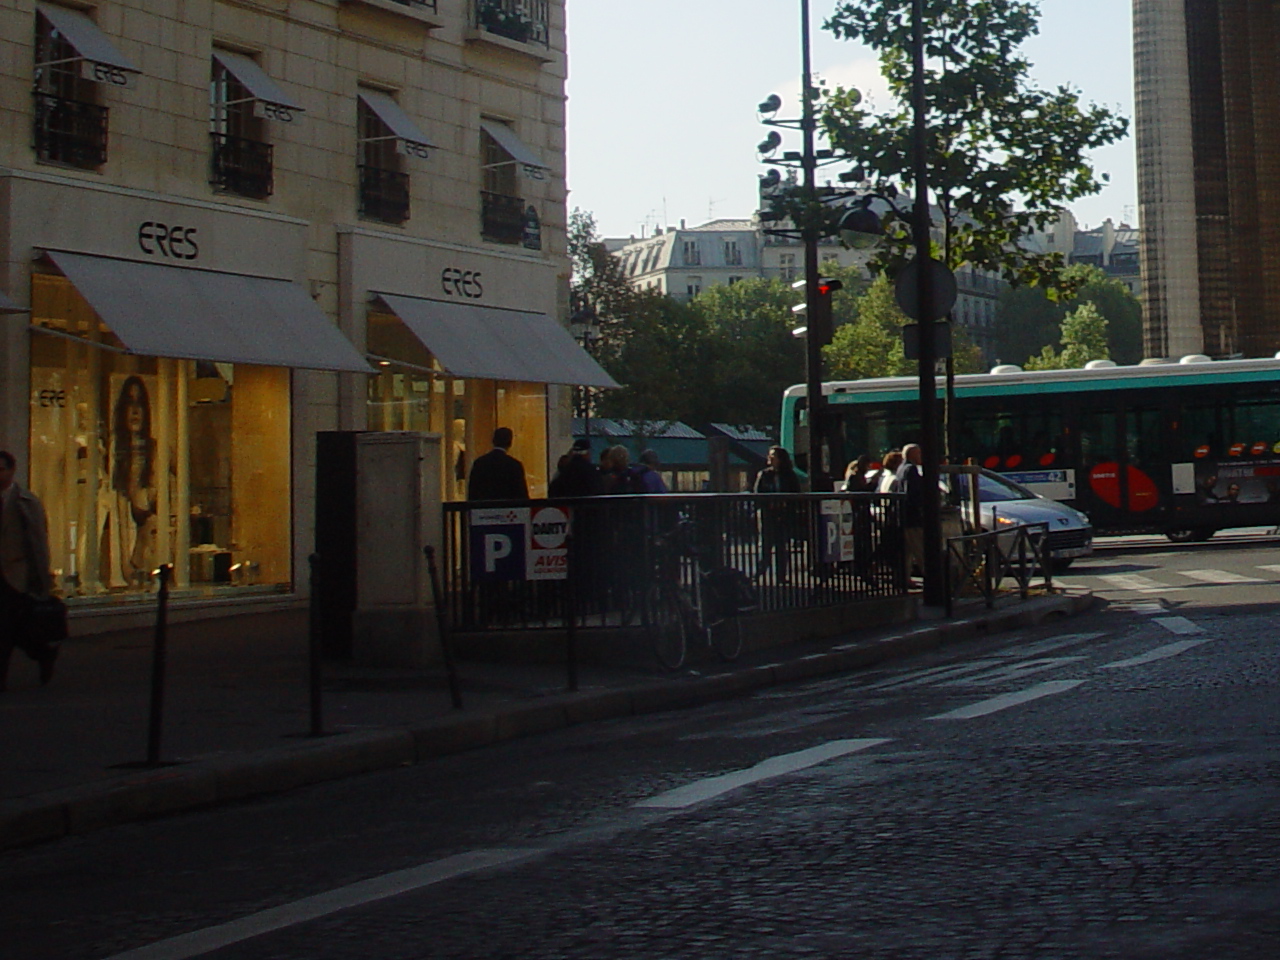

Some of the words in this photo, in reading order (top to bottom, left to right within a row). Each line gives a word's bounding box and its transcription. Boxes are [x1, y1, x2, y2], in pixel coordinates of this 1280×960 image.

[139, 221, 199, 260] ERES
[442, 267, 483, 298] ERES
[1048, 471, 1062, 482] 42
[533, 522, 567, 535] DARTY
[826, 521, 837, 555] P
[484, 533, 512, 572] P
[535, 555, 567, 567] AVIS
